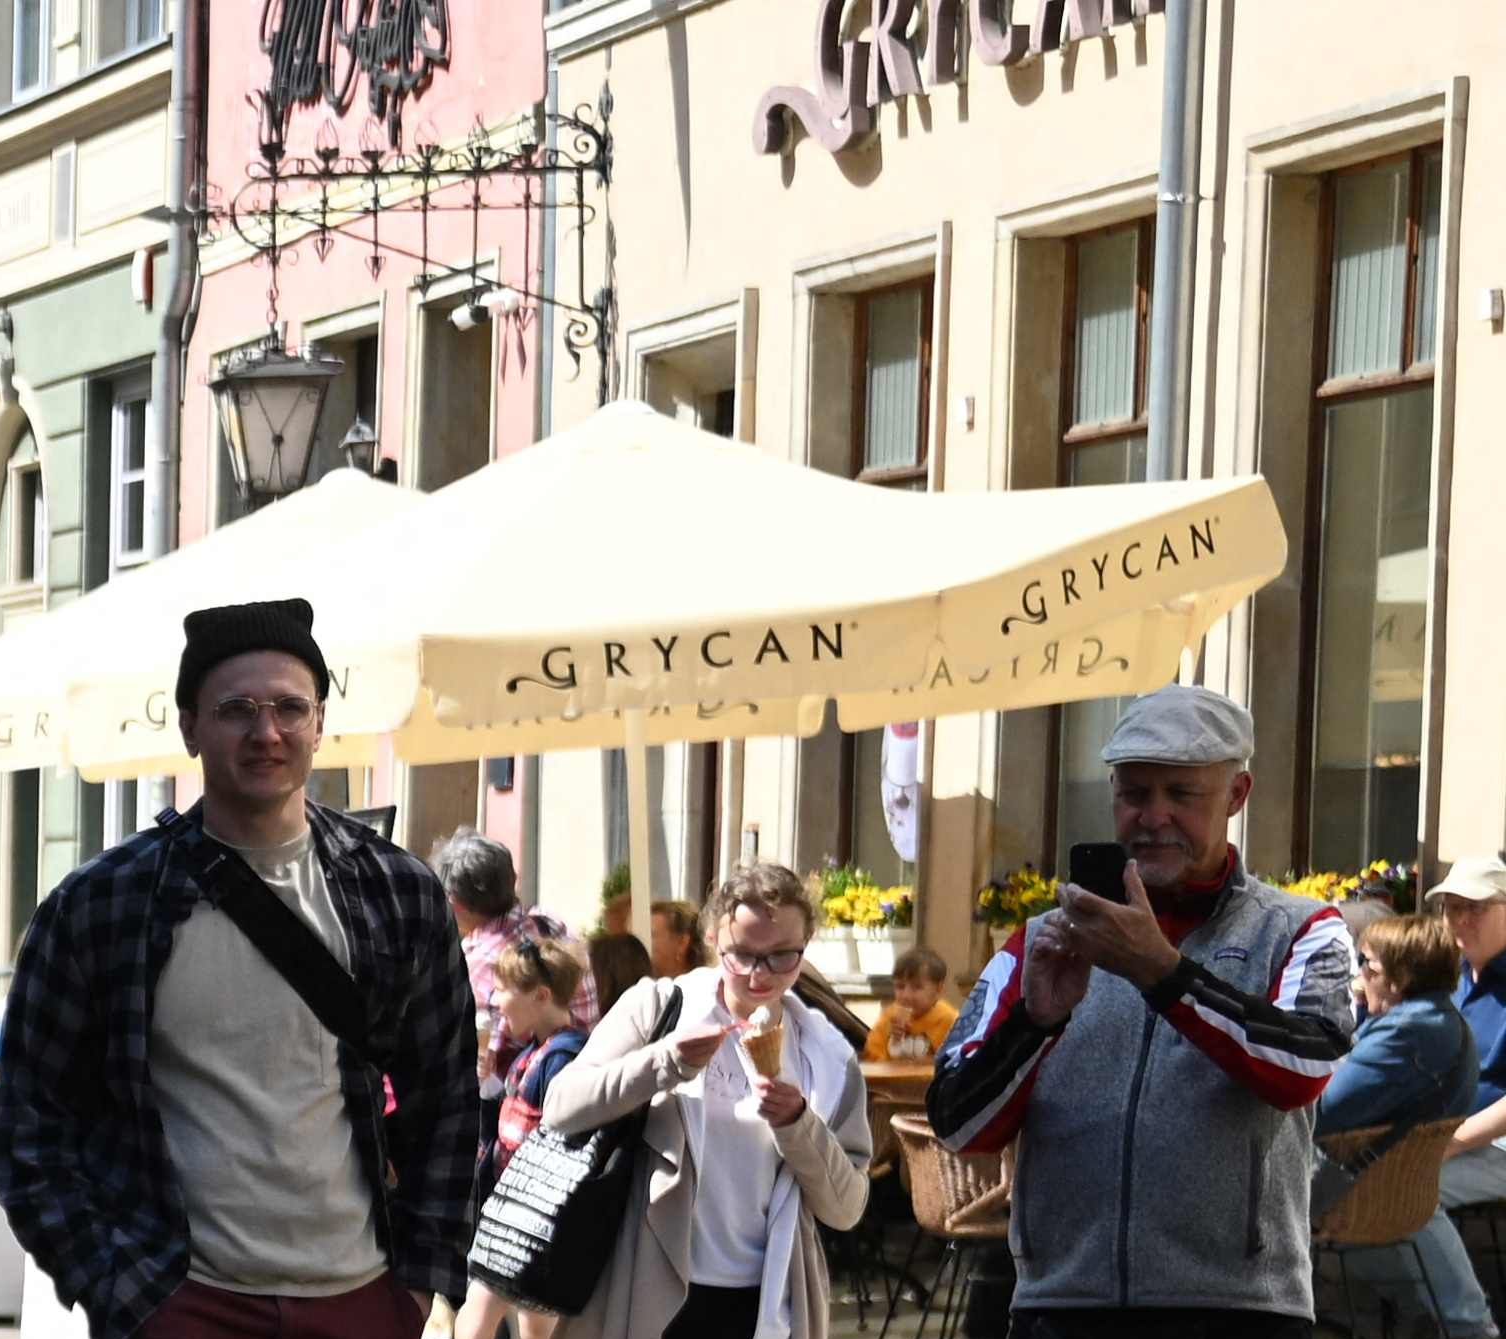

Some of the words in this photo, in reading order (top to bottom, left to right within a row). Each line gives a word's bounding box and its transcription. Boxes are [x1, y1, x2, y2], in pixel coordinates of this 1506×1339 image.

[753, 0, 1164, 153] GRYC
[1001, 517, 1216, 635] GRYCAN
[505, 621, 843, 693] GRYCAN
